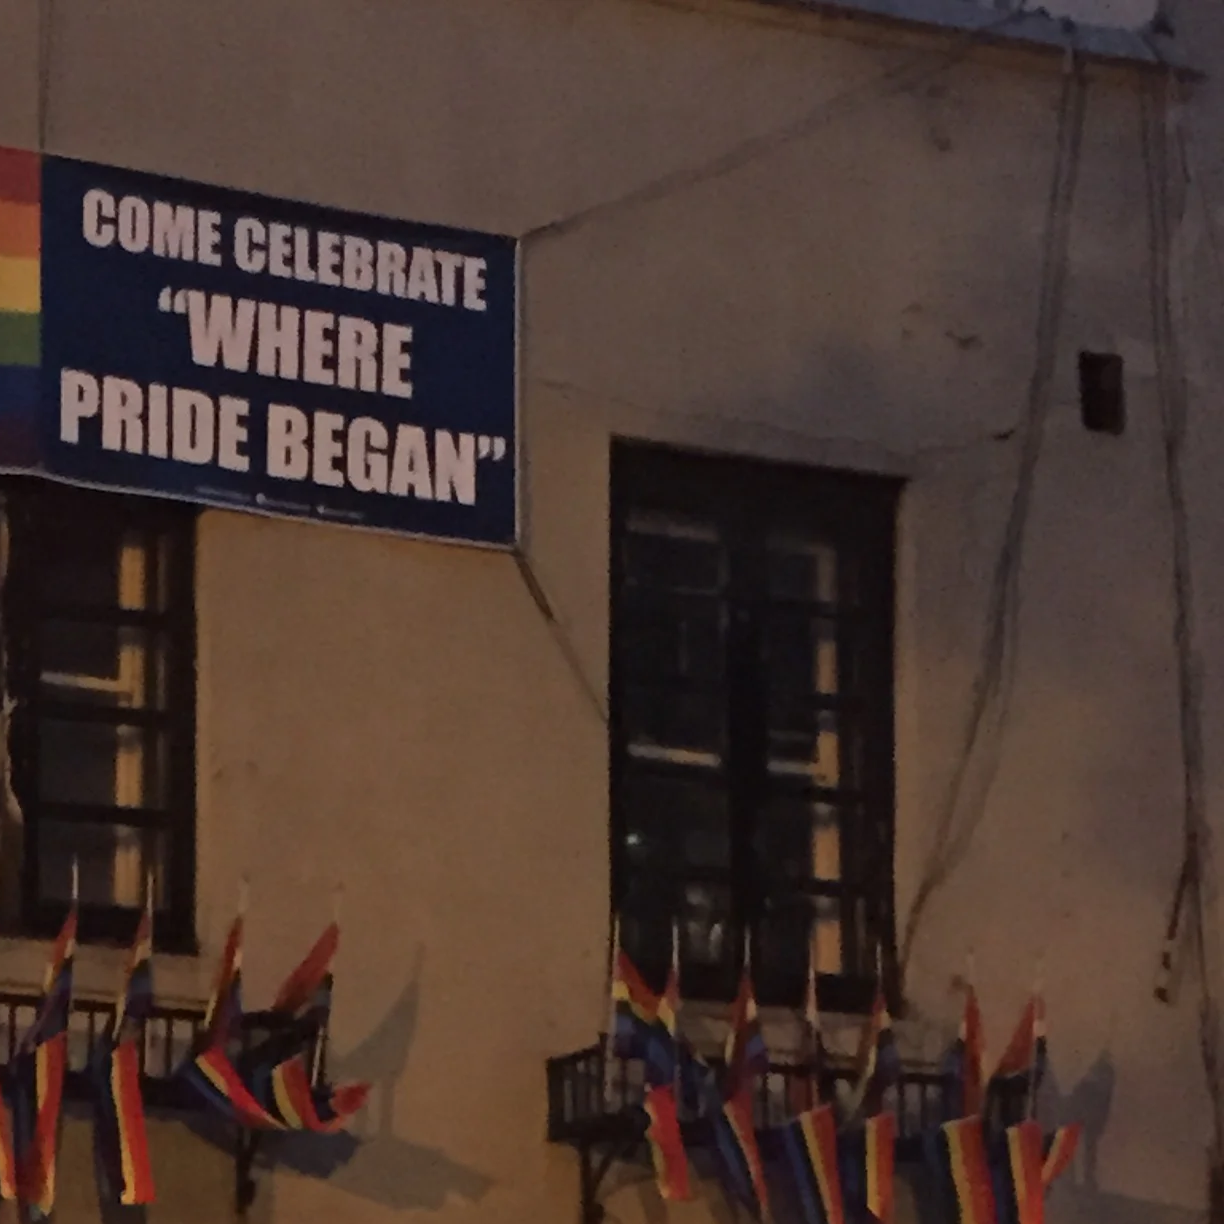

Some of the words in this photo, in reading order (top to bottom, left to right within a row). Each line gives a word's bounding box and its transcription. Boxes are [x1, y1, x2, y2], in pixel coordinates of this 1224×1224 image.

[82, 188, 223, 266] COME
[233, 216, 488, 311] CELEBRATE
[158, 286, 414, 399] “WHERE
[59, 367, 250, 472] PRIDE
[266, 403, 506, 505] BEGAN”
